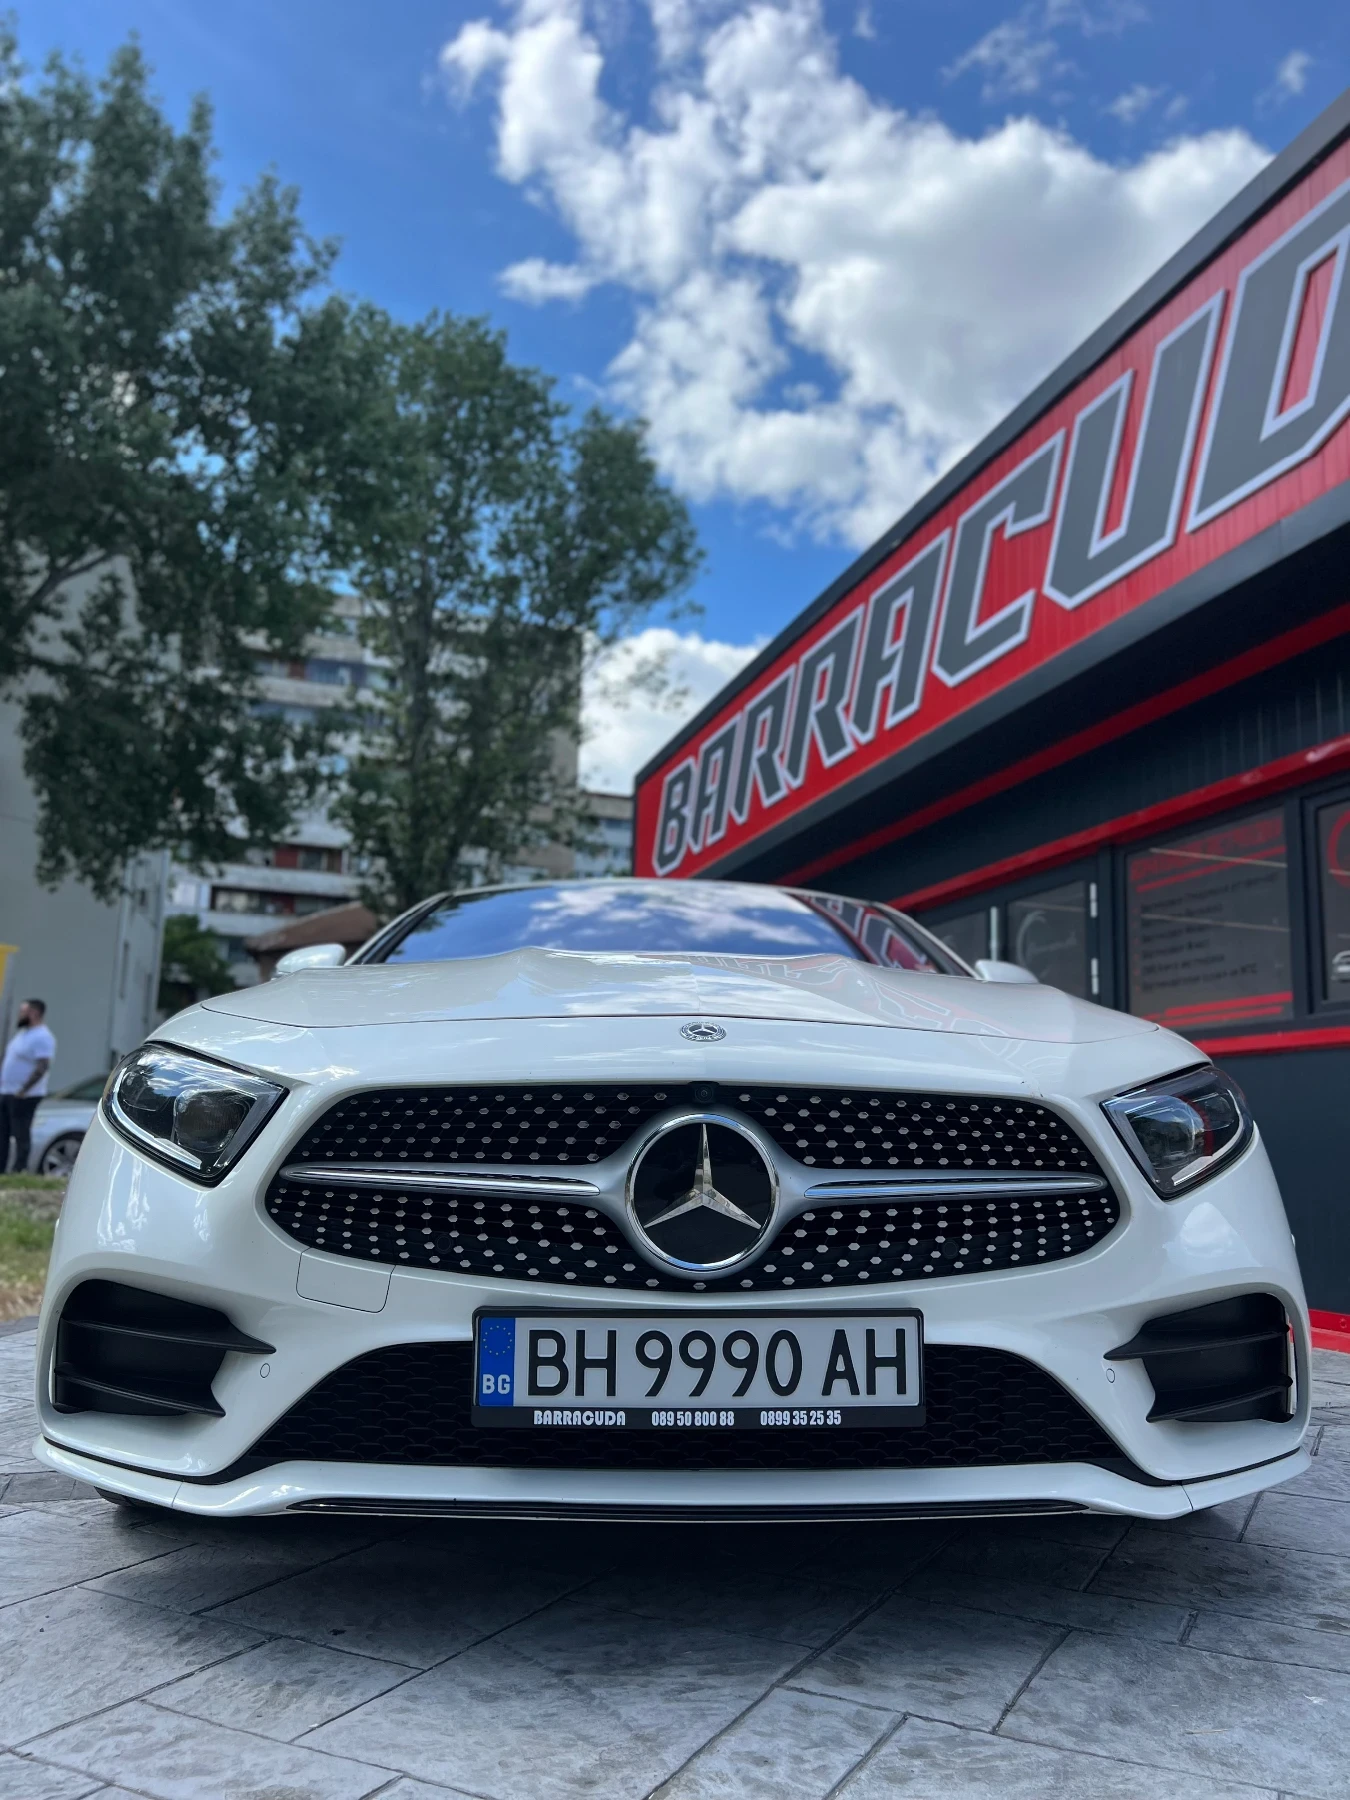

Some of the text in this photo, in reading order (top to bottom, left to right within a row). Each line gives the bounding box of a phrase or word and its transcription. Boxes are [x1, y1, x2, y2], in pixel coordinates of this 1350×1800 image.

[527, 1328, 907, 1397] BH 9990 AH
[482, 1373, 511, 1395] BG
[533, 1410, 626, 1426] BARRACUDA
